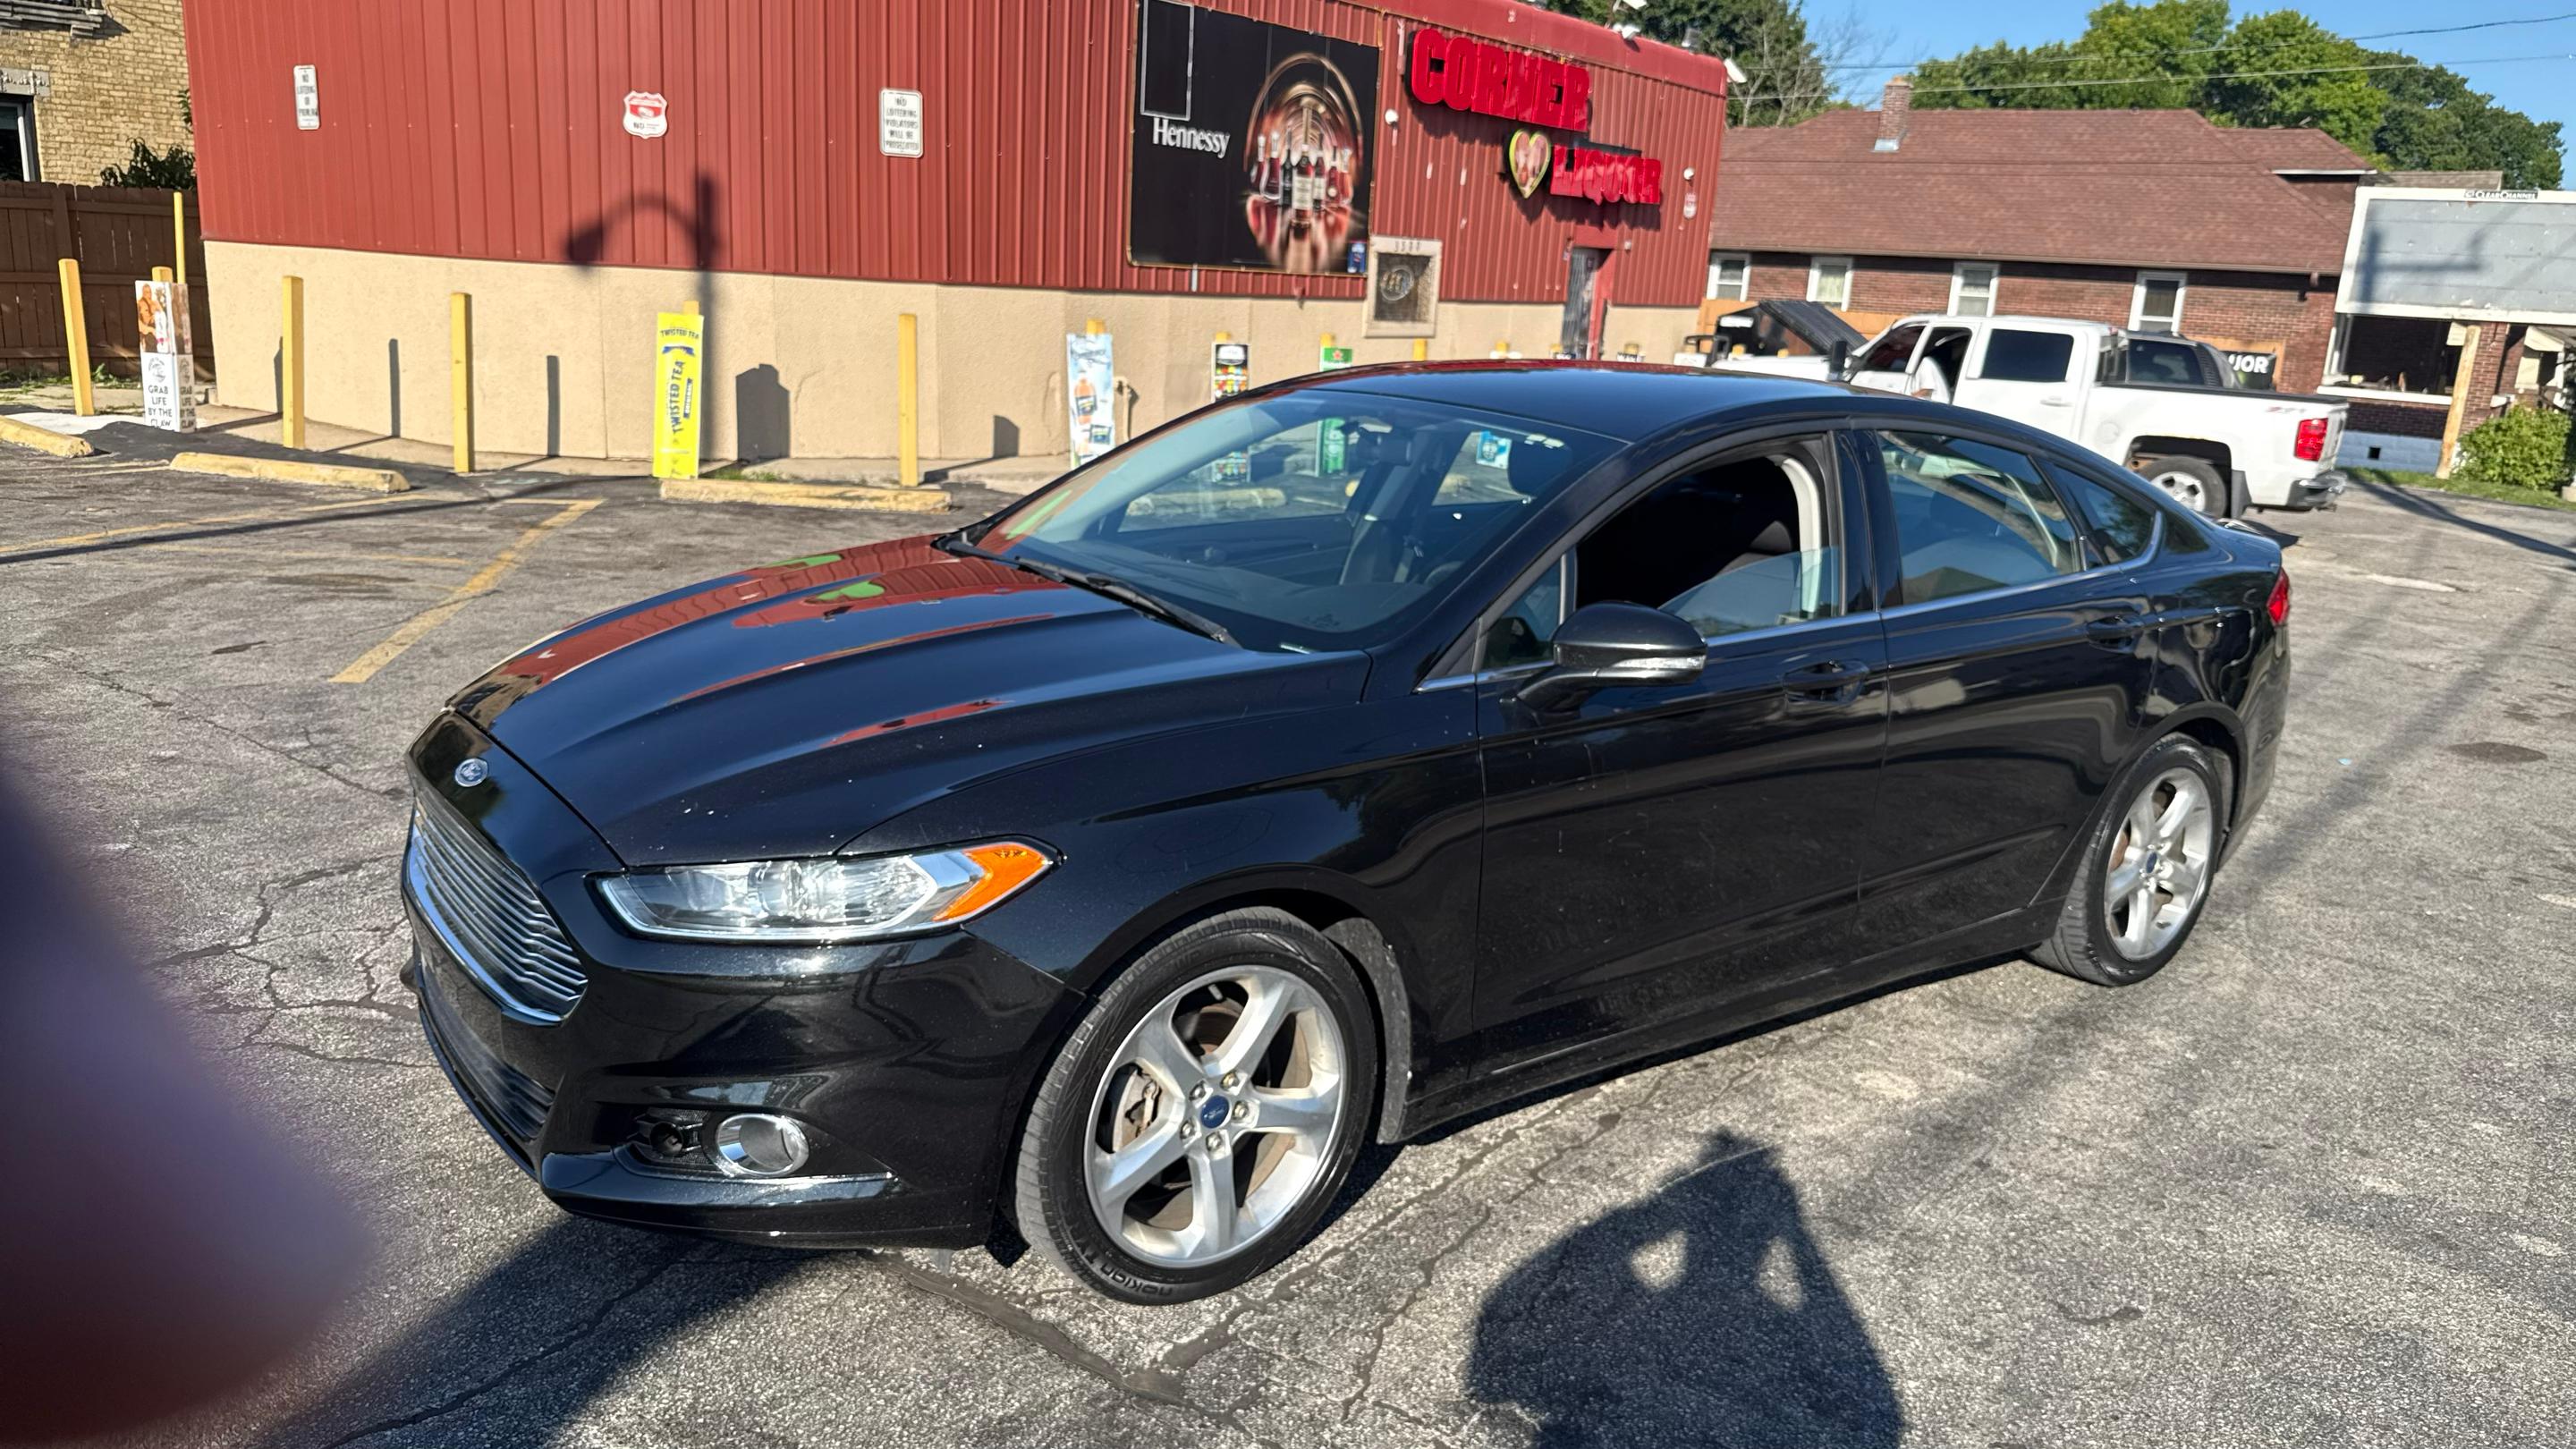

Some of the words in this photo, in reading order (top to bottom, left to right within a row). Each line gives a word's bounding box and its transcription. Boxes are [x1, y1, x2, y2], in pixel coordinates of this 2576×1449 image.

[1411, 28, 1590, 132] CORNER
[1153, 116, 1231, 159] Hennessy
[660, 328, 688, 337] TWISTED
[671, 360, 686, 381] TEA
[148, 385, 168, 394] GRAB
[151, 396, 167, 406] LIFE
[148, 408, 157, 416] BY
[158, 408, 173, 418] THE
[669, 384, 684, 435] TWISTED
